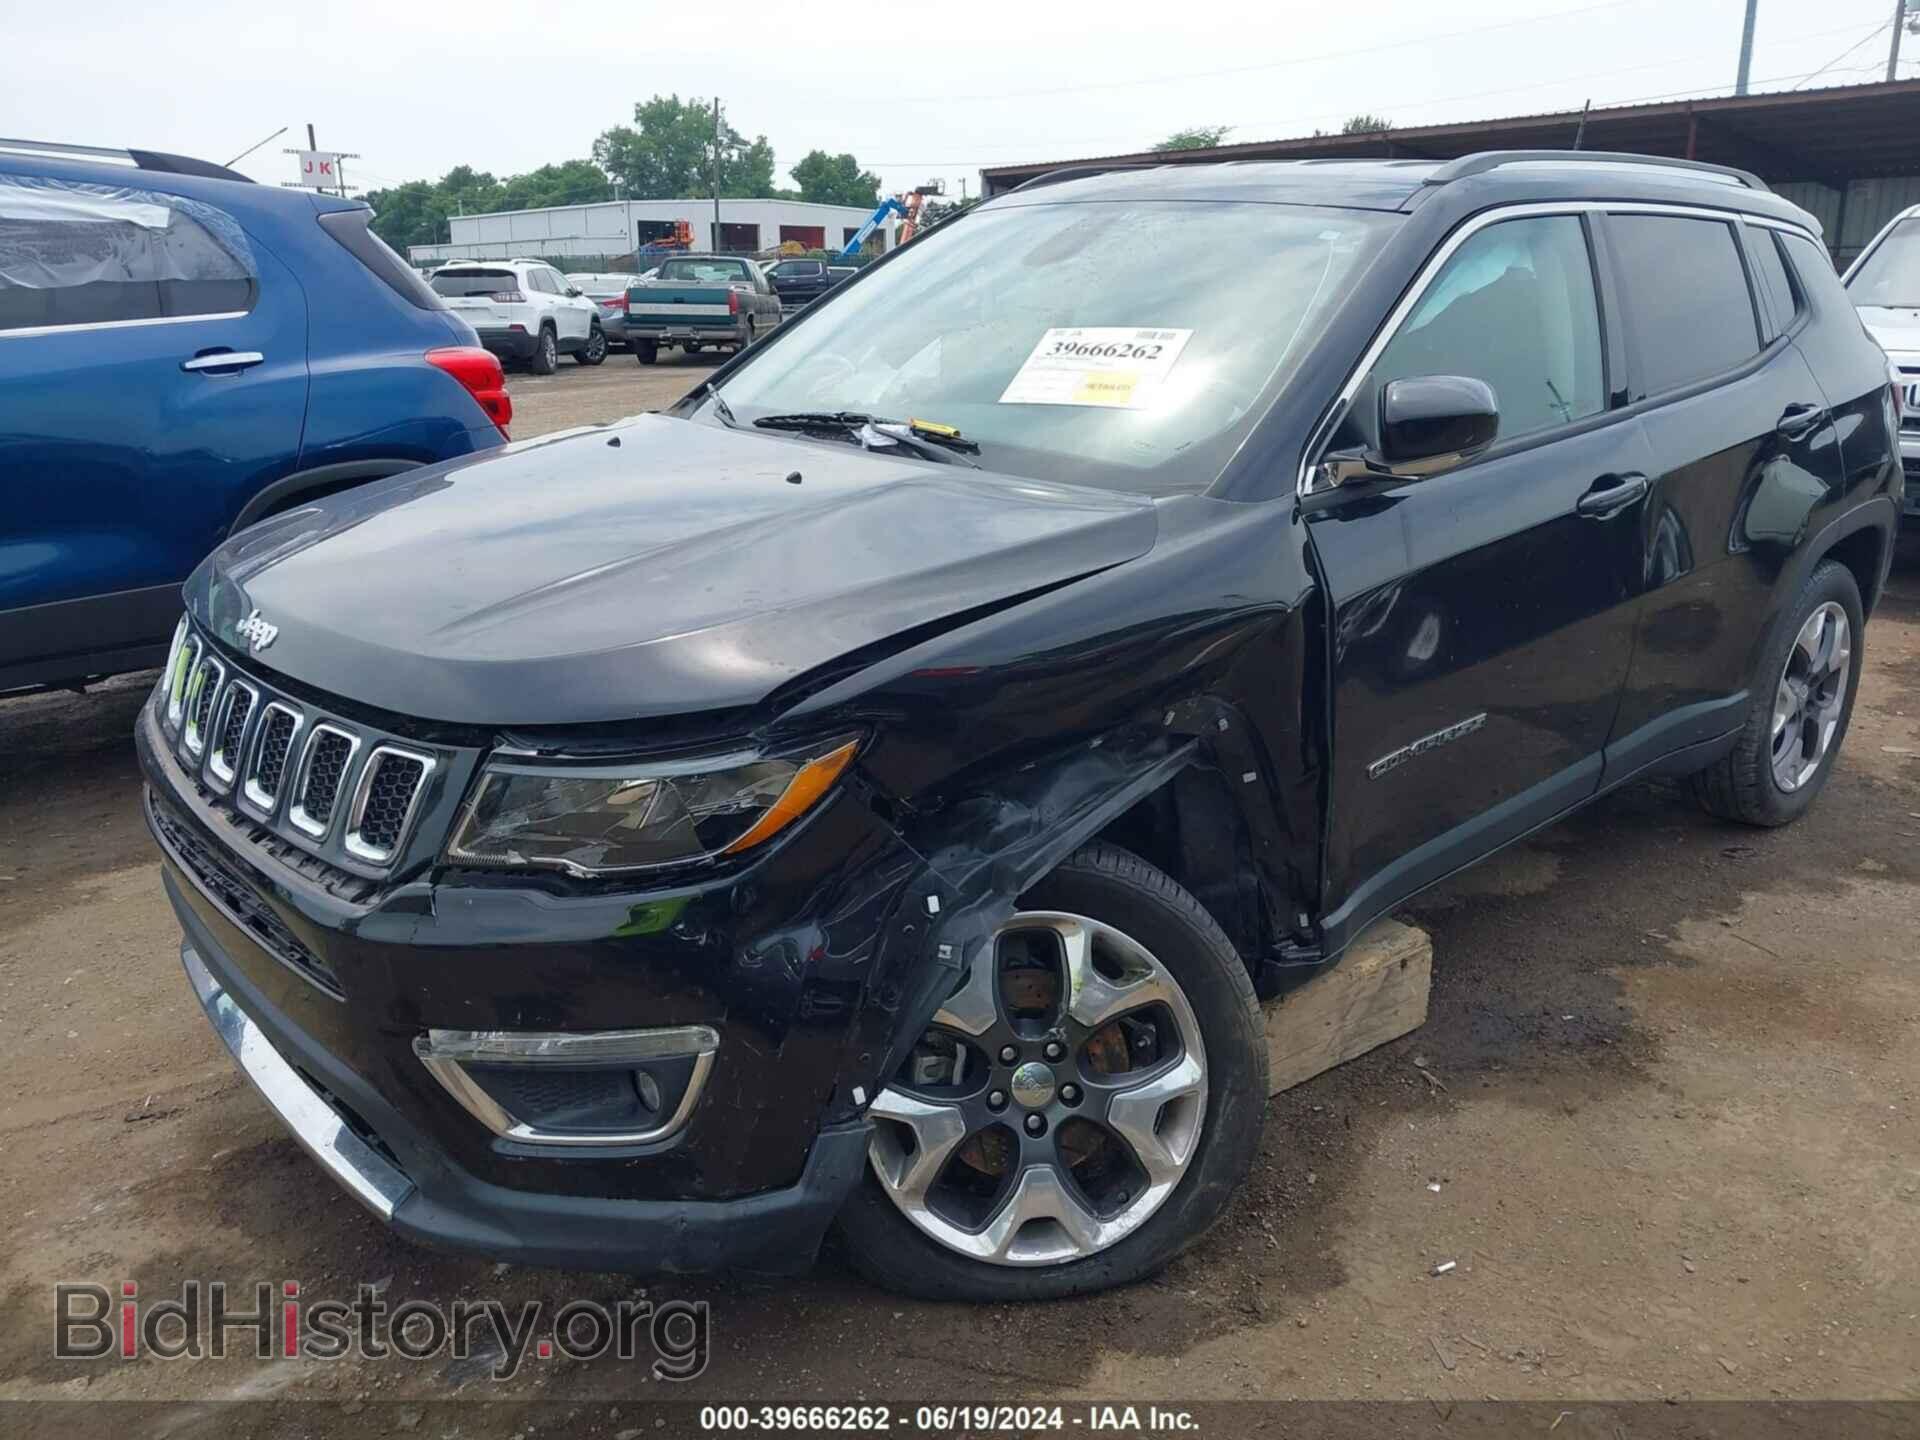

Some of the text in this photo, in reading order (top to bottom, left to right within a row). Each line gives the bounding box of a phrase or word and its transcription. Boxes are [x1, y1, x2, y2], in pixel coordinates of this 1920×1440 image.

[303, 160, 332, 175] J K
[1045, 341, 1164, 361] 39666262
[235, 608, 279, 652] Jeep
